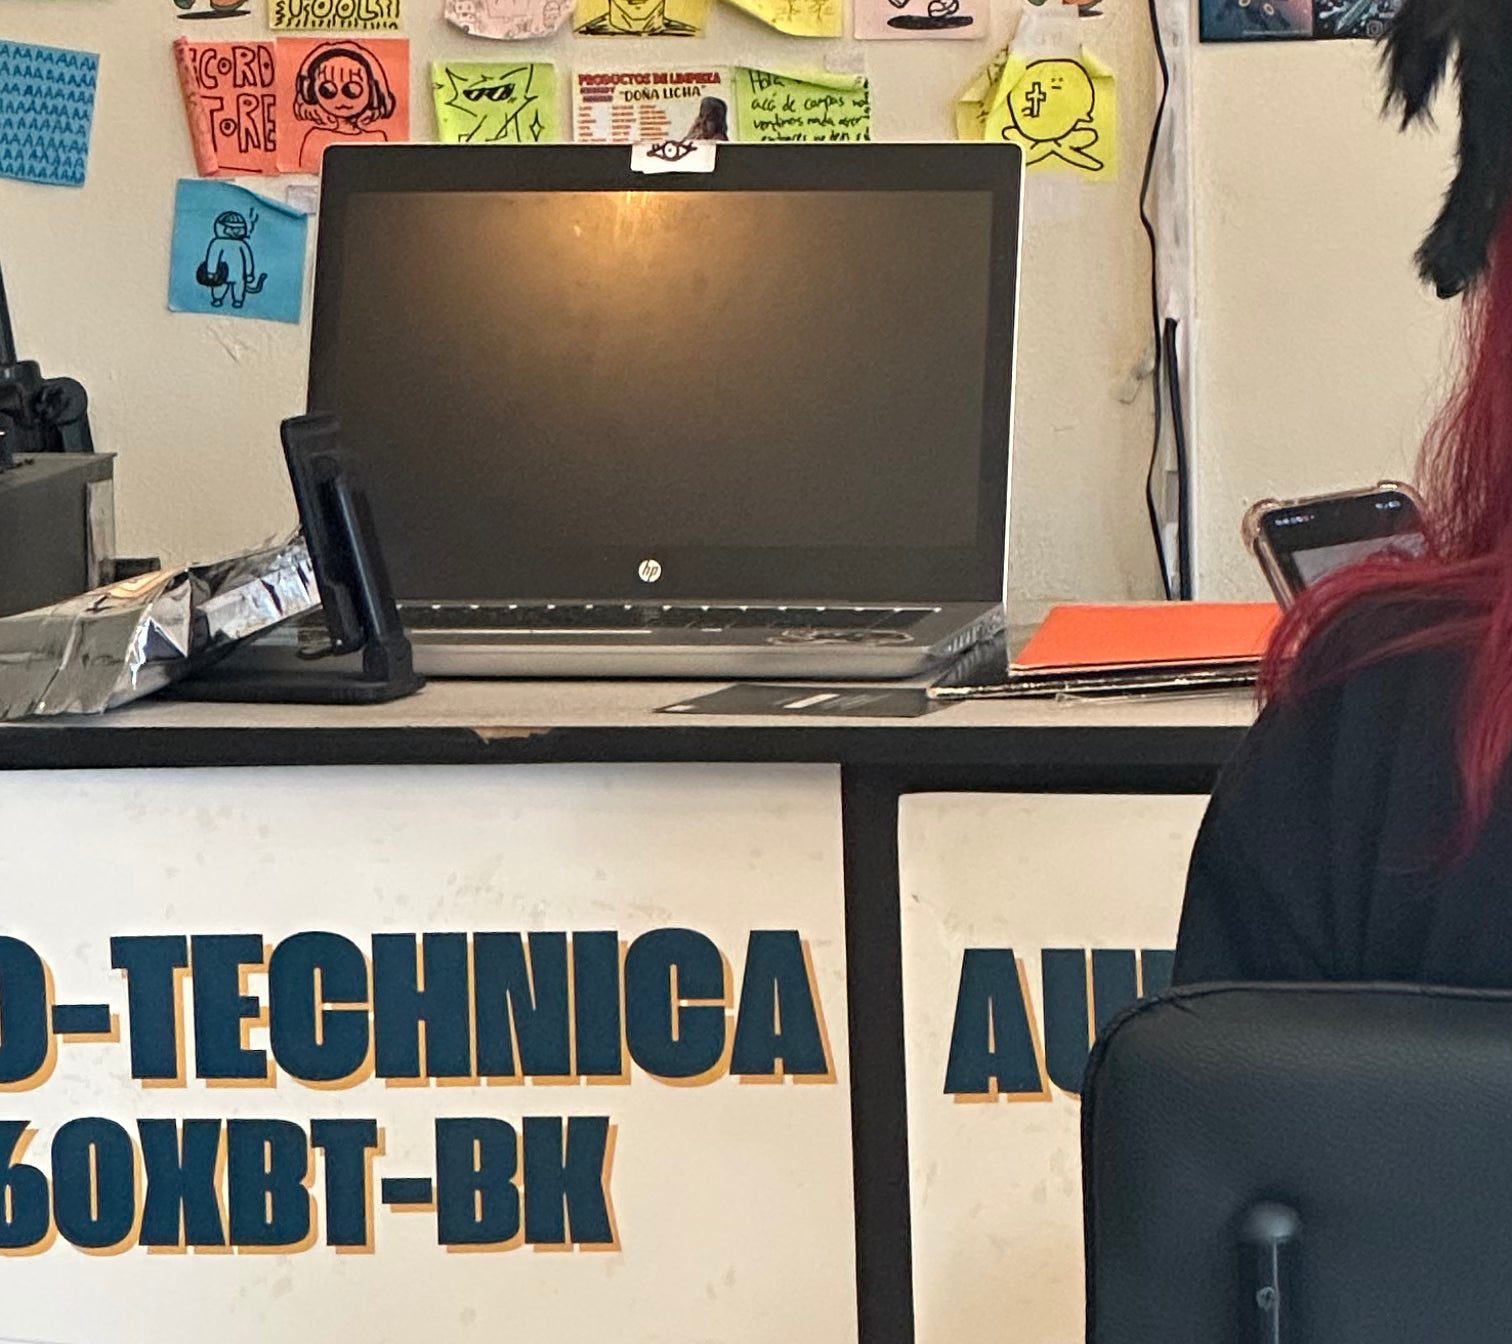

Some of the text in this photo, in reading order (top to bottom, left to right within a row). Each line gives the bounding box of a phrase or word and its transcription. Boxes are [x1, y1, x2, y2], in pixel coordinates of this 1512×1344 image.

[578, 72, 720, 85] PRODUCTOS DE LIMPIEZA
[783, 94, 795, 112] de
[200, 92, 277, 154] TORE
[642, 561, 659, 581] hp
[0, 1116, 615, 1248] 60XBT-BK
